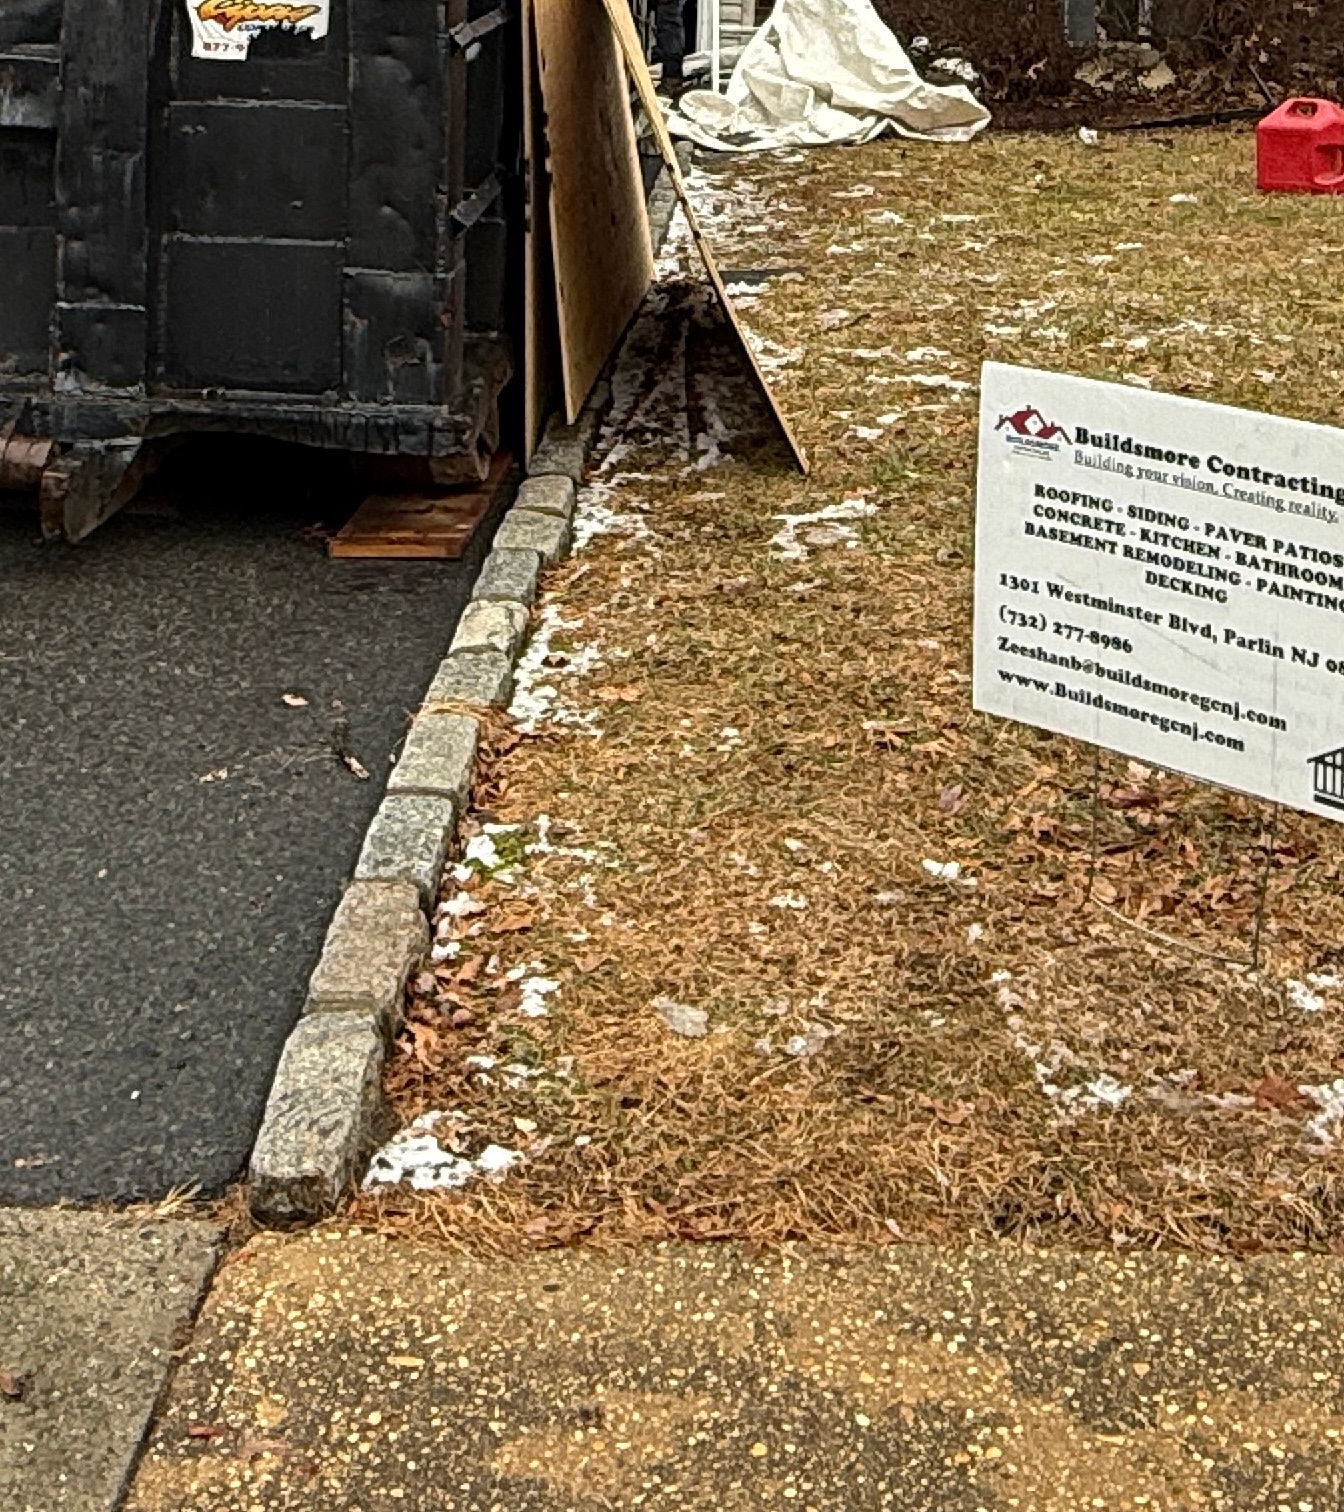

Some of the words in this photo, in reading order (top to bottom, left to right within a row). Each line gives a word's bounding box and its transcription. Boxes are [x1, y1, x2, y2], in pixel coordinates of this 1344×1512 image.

[1074, 426, 1201, 470] Buildsmore
[1074, 449, 1134, 478] Building
[1136, 466, 1170, 484] your
[1222, 482, 1286, 513] Creating
[1024, 520, 1118, 555] BASEMENT
[1122, 544, 1242, 586] REMODELING
[1033, 504, 1126, 537] CONCRETE
[1139, 527, 1221, 560] KITCHEN
[1235, 550, 1344, 591] BATHROOM
[1034, 483, 1114, 513] ROOFING
[1126, 504, 1190, 531] SIDING
[1204, 522, 1268, 551] PAVER
[1272, 538, 1344, 568] PATIOS
[998, 572, 1040, 595] 1301
[1046, 580, 1164, 626] Westminster
[1168, 612, 1218, 644] Blvd,
[1223, 627, 1285, 659] Parlin
[1290, 645, 1320, 668] NJ
[1144, 570, 1228, 604] DECKING
[998, 604, 1047, 632] (732)
[1052, 621, 1134, 654] 277-8986
[997, 635, 1288, 732] Zeeshanb@buildsmoregcnj.com
[997, 668, 1246, 752] www.Buildsmoregcnj.com
